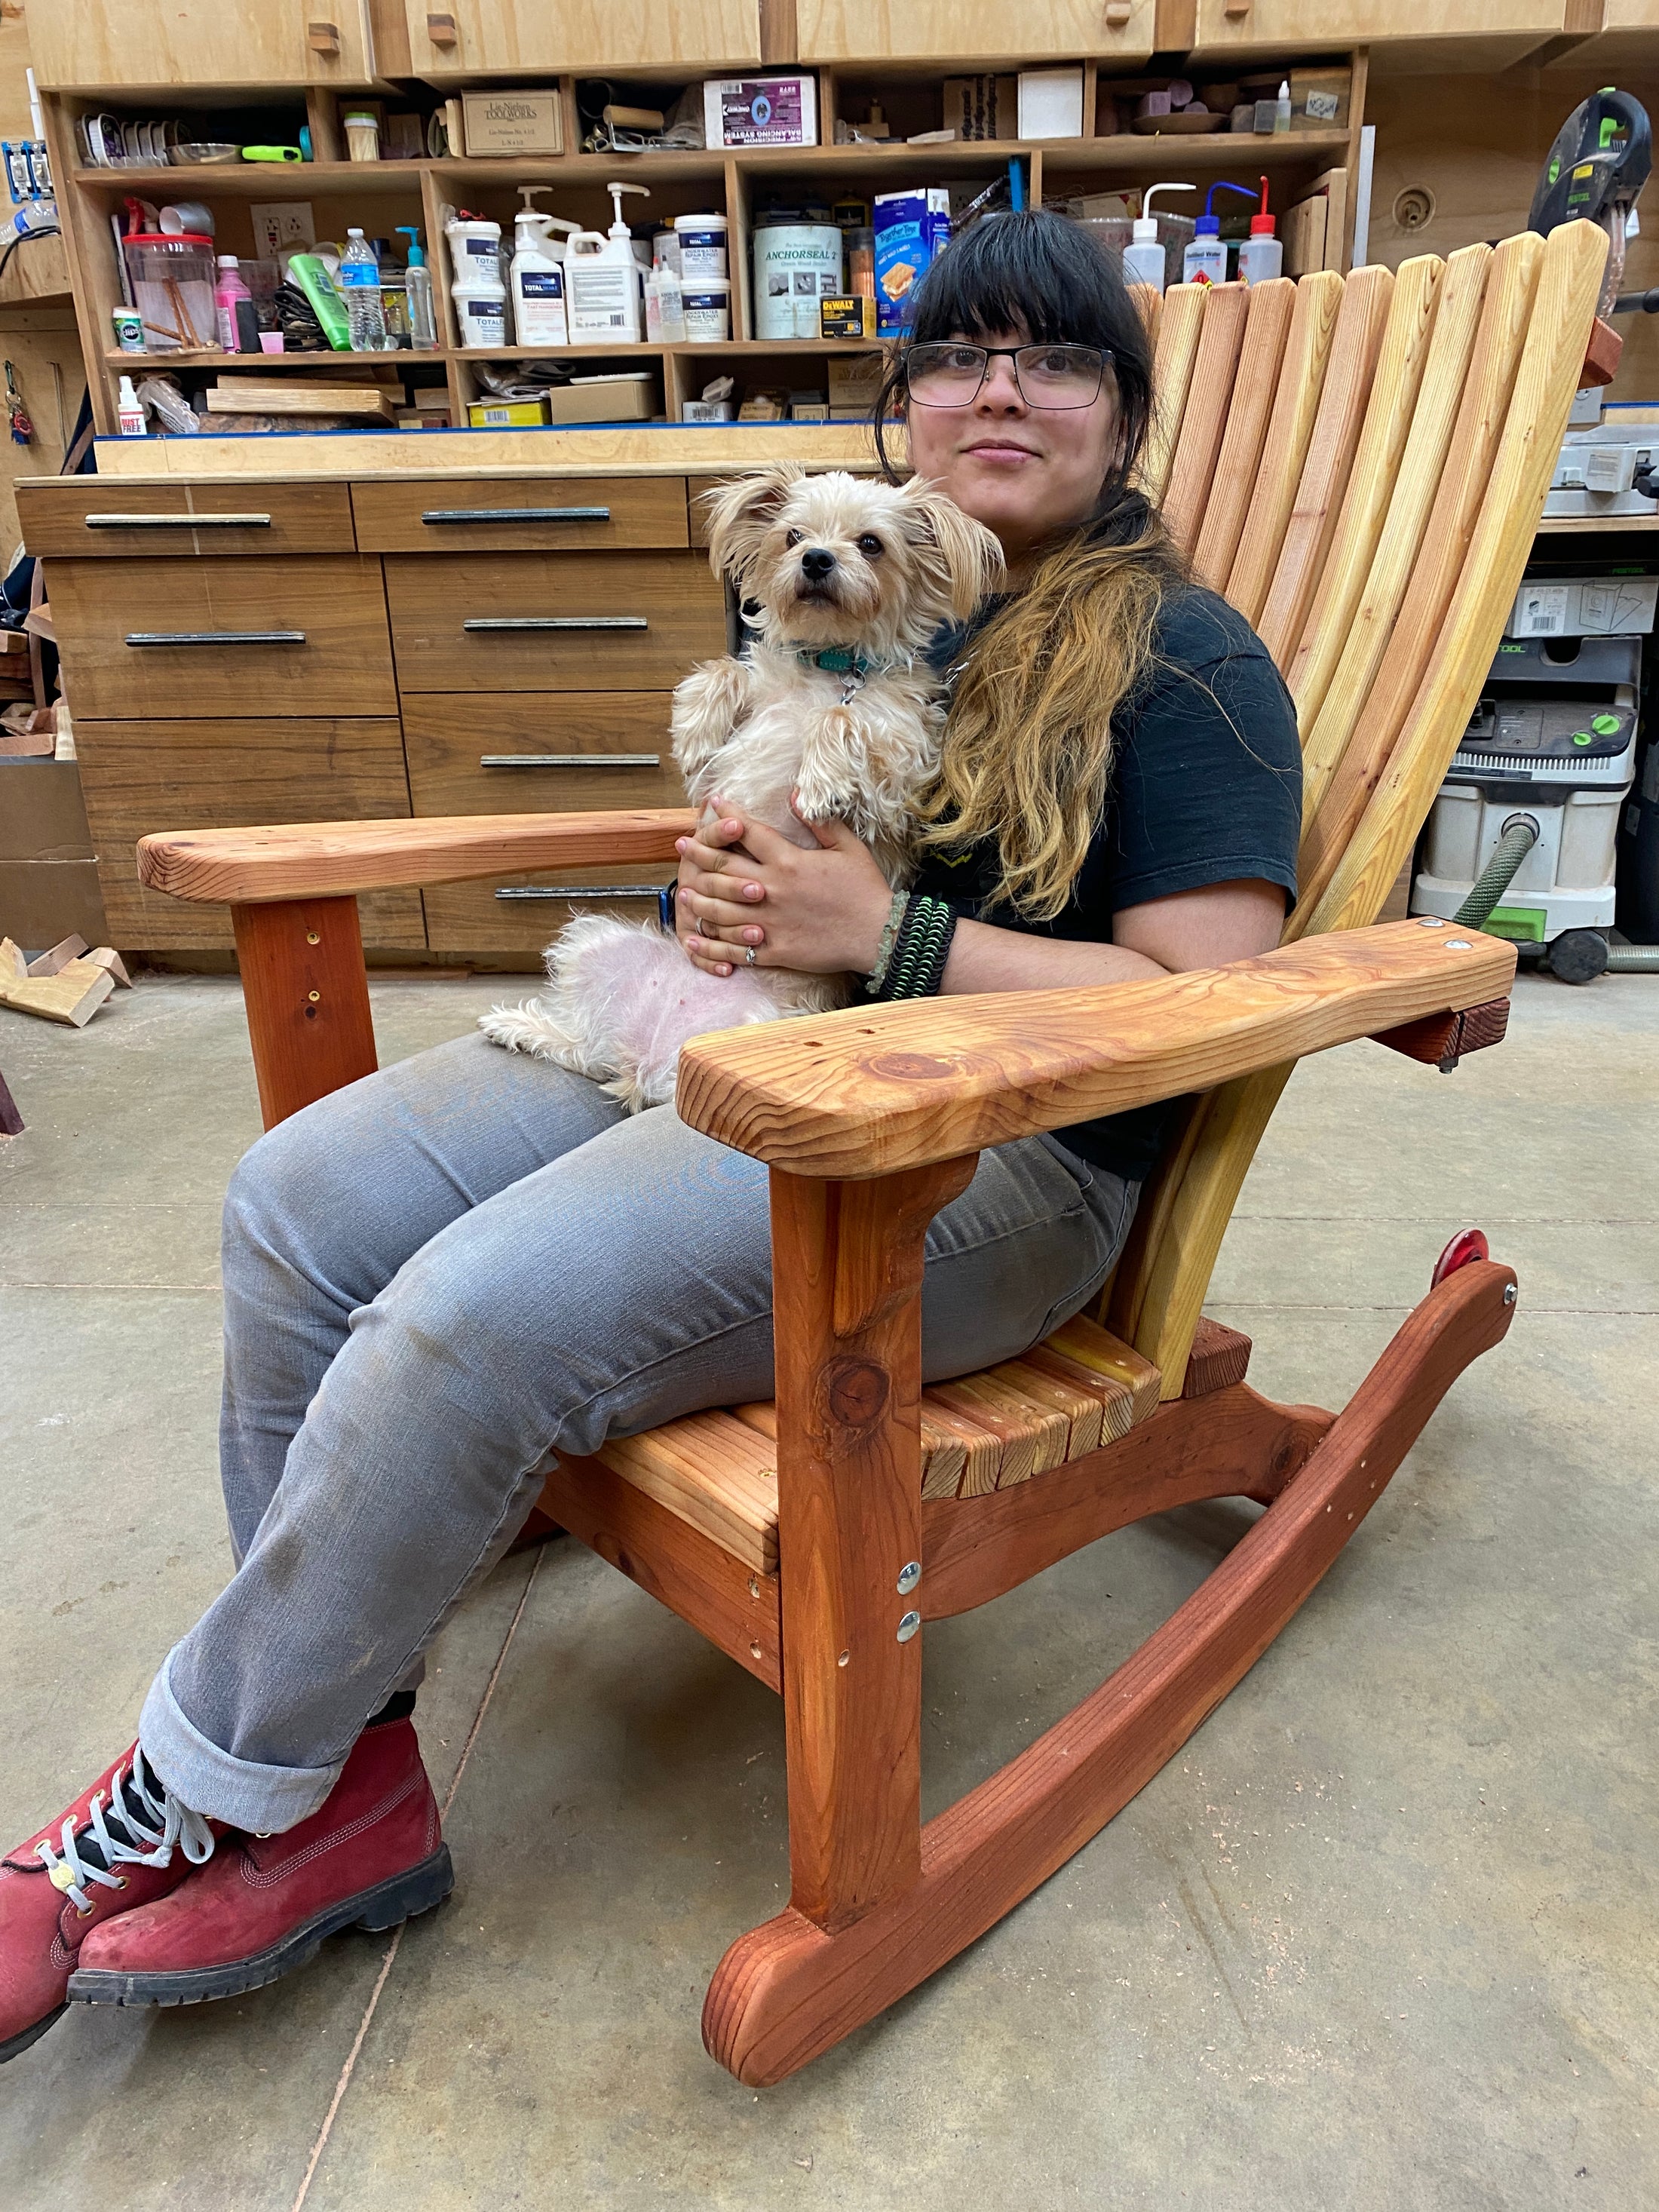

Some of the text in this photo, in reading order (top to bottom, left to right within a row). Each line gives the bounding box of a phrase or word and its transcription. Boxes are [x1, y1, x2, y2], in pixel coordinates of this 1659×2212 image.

[485, 110, 537, 119] TOOLWORKS
[765, 250, 836, 260] ANCHORSEAL 2
[474, 256, 499, 265] TOTAL
